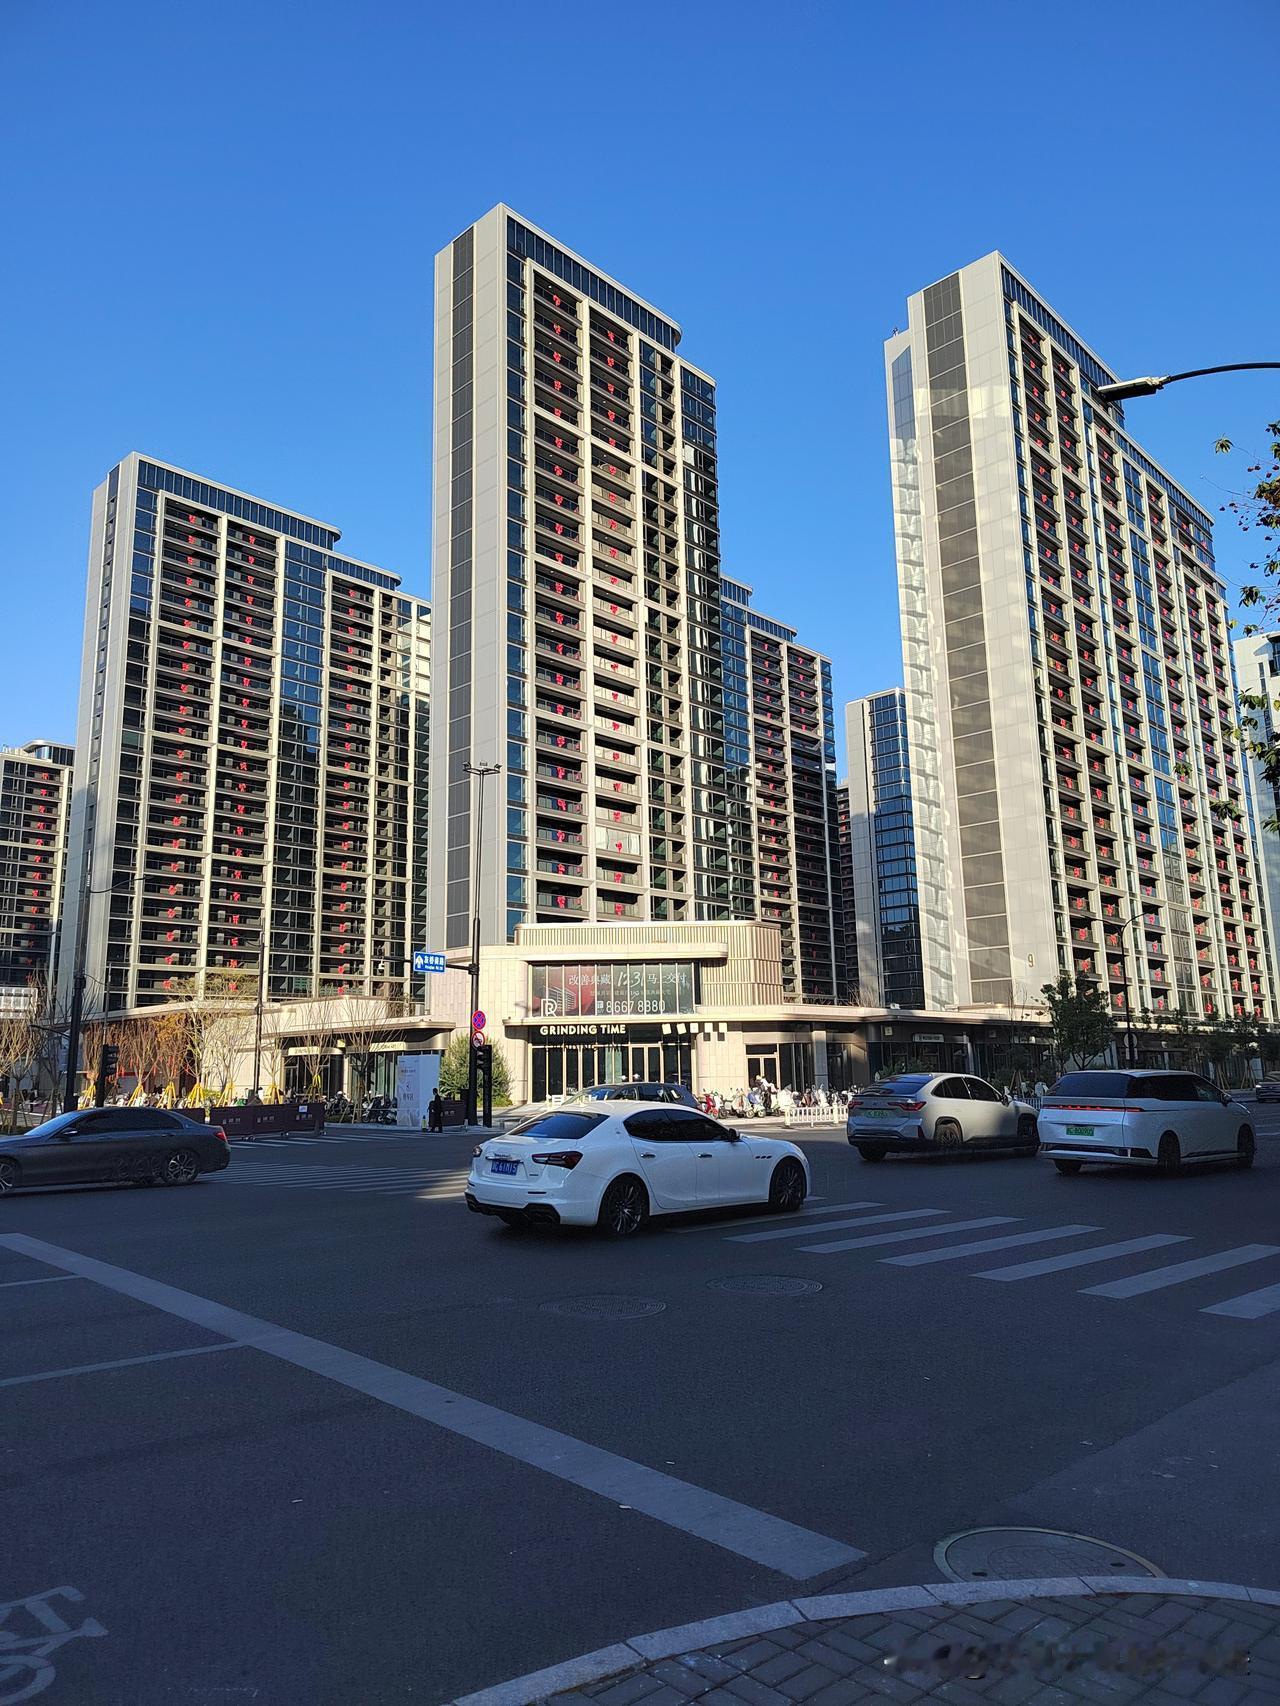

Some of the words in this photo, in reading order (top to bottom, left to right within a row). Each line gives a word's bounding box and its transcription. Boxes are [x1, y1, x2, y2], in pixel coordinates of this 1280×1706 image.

[1027, 953, 1034, 968] 9
[540, 1024, 598, 1036] GRINDING
[600, 1024, 627, 1034] TIME
